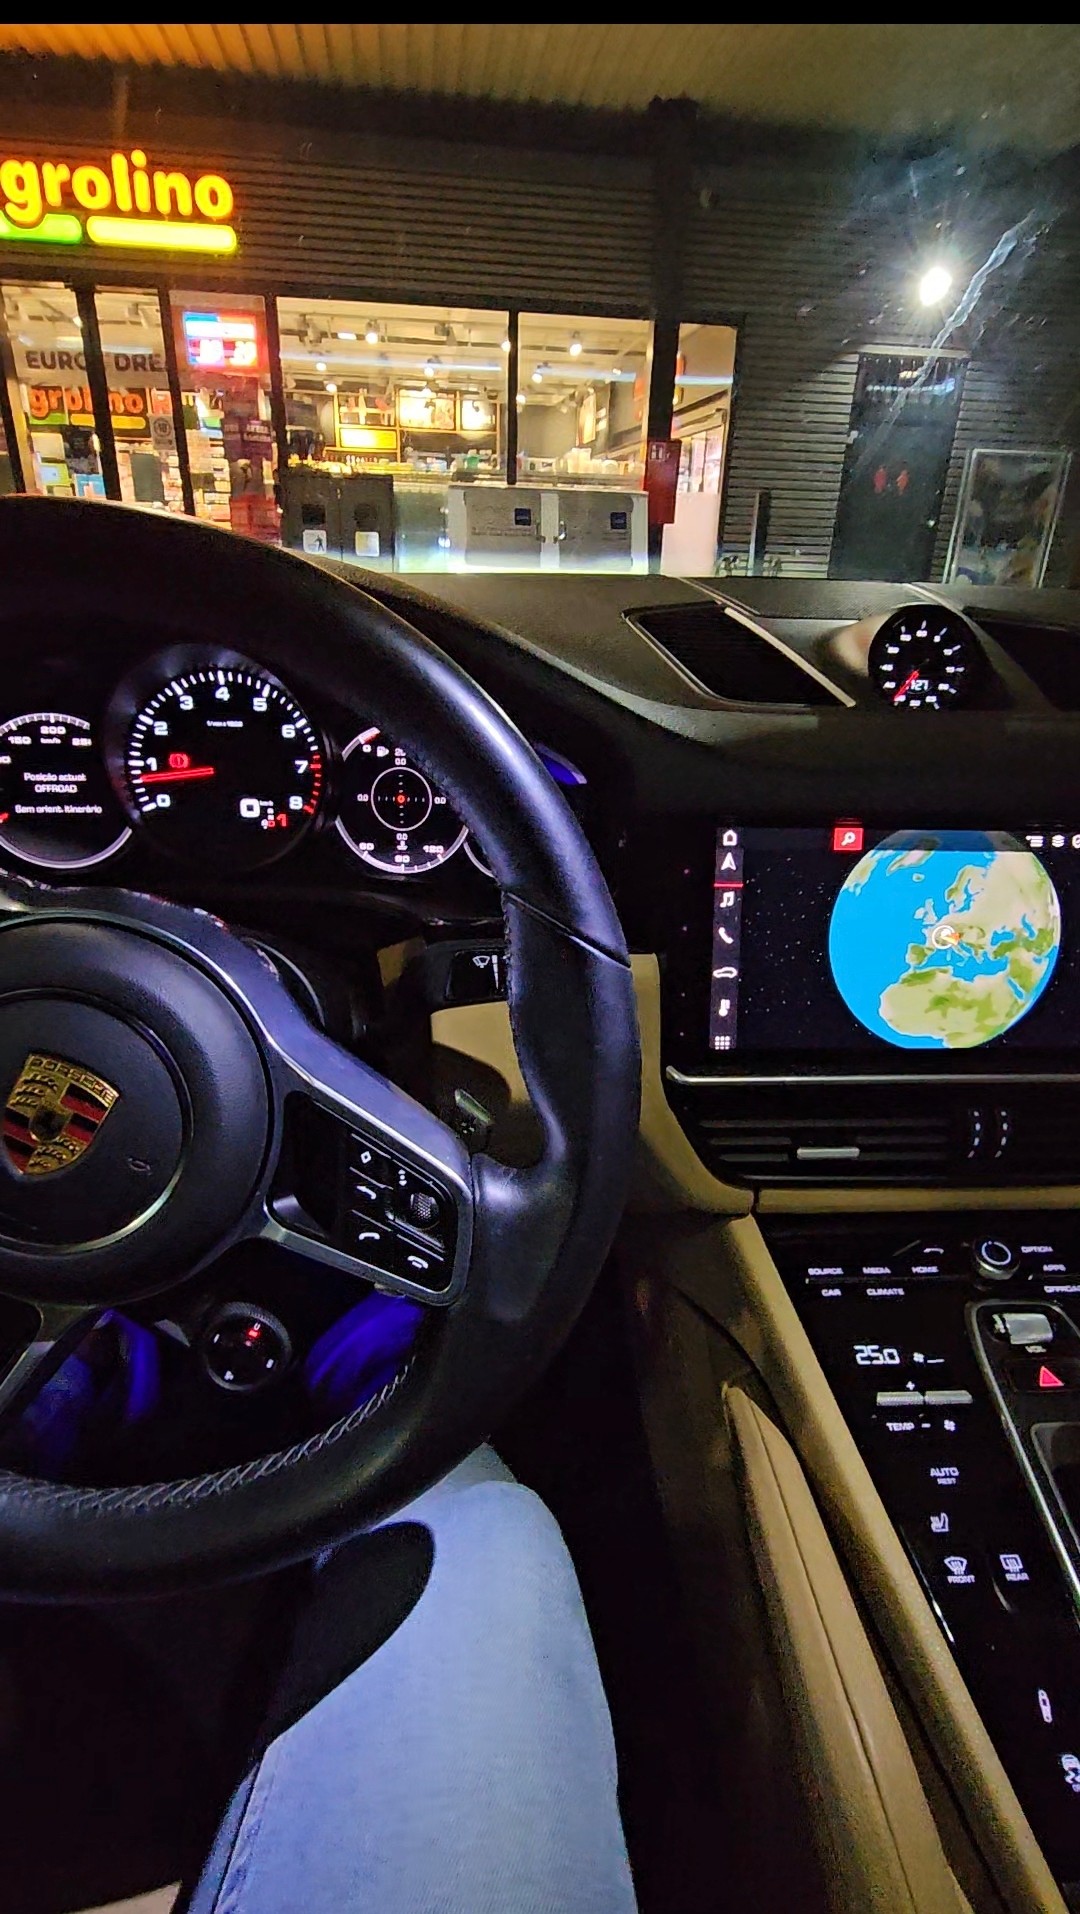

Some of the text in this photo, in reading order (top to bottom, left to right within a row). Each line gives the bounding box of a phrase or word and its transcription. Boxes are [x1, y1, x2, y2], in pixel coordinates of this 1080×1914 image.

[0, 150, 234, 224] grolino
[31, 386, 144, 418] grolno
[215, 686, 230, 701] 4
[179, 695, 194, 710] 3
[253, 697, 267, 711] 5
[40, 726, 66, 734] 200
[154, 721, 168, 736] 2
[281, 724, 296, 738] 6
[146, 757, 157, 771] 1
[295, 760, 308, 774] 7
[156, 794, 170, 808] 0
[289, 796, 303, 810] 8
[821, 1288, 842, 1297] CAR
[886, 1422, 915, 1431] TEMP
[930, 1467, 959, 1477] AUTO
